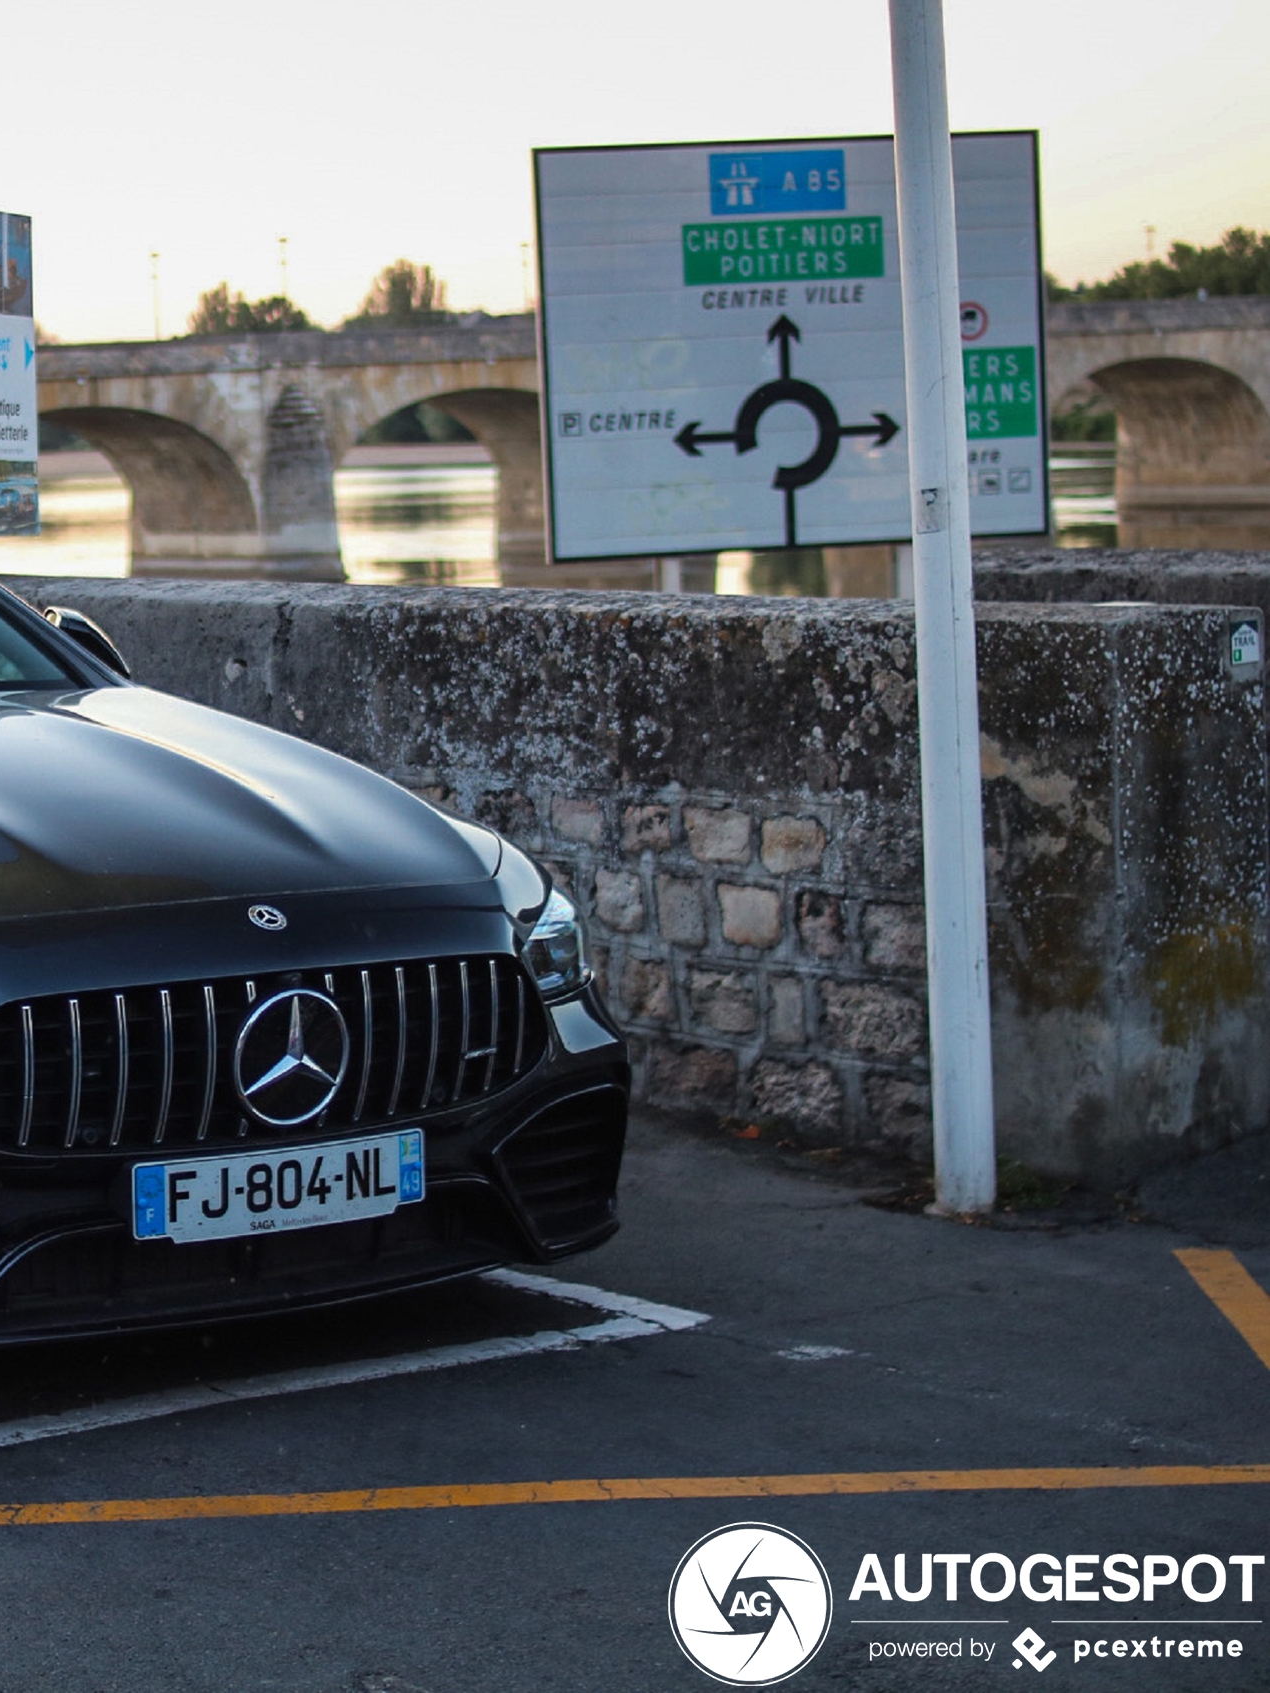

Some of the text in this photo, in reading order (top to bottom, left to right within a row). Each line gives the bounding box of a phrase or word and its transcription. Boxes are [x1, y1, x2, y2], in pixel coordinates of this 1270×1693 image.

[782, 169, 841, 192] A 85
[686, 222, 879, 252] CHOLET-NIORT
[721, 251, 848, 277] POITIERS
[701, 283, 865, 310] CENTRE VILLE
[969, 355, 1019, 377] ERS
[589, 409, 676, 432] CENTRE
[969, 410, 1000, 432] RS
[968, 450, 1000, 464] are
[168, 1147, 396, 1223] FJ-804-NL
[401, 1170, 420, 1195] 49
[145, 1207, 154, 1224] F
[249, 1219, 276, 1231] SAGA
